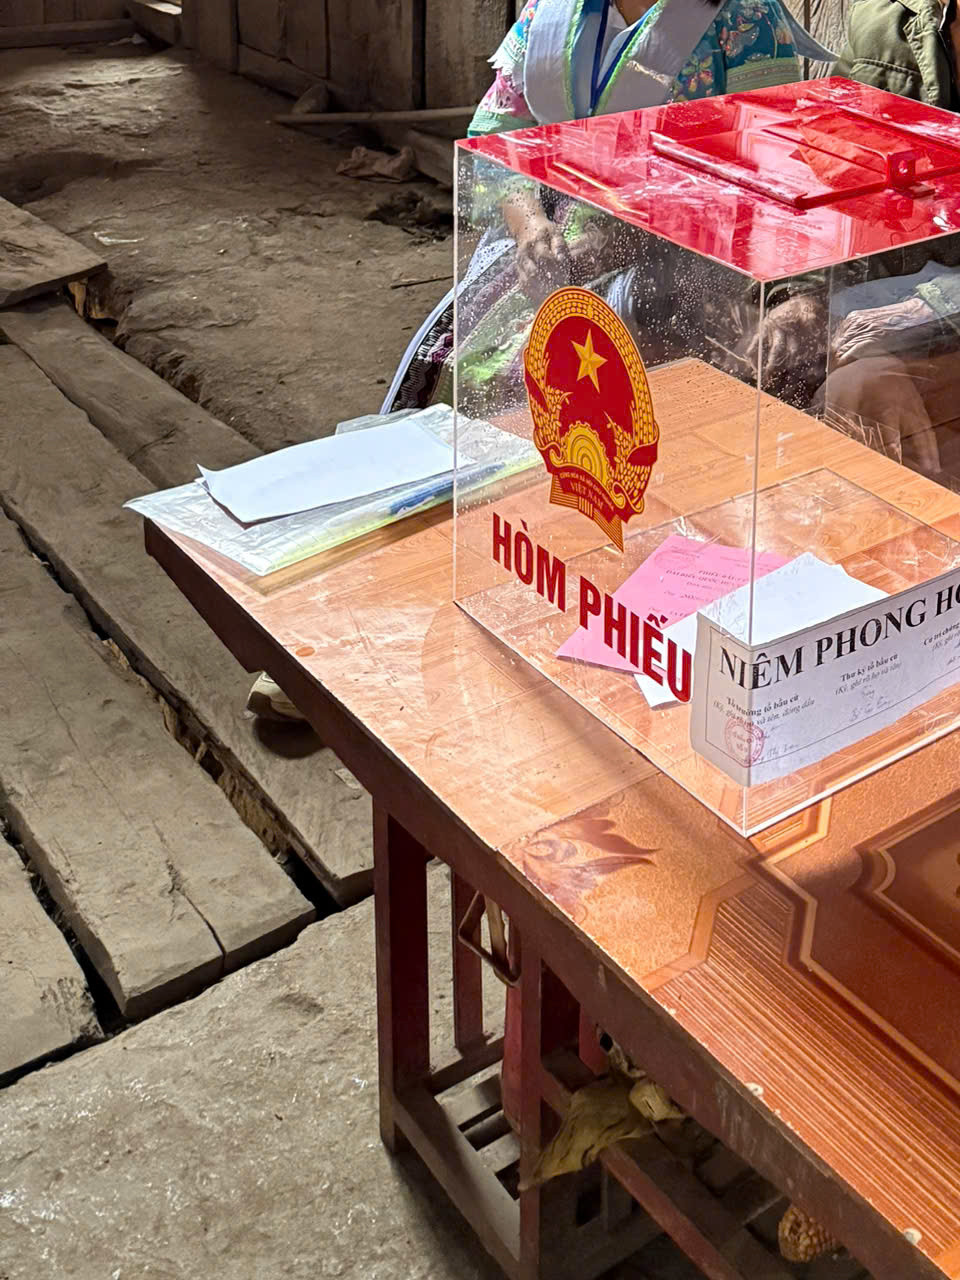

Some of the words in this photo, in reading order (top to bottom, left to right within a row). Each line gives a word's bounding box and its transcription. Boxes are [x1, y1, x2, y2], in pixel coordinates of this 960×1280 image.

[492, 512, 565, 613] HÒM
[580, 575, 692, 703] PHIẾU
[720, 645, 804, 690] NIÊM
[815, 597, 927, 667] PHONG
